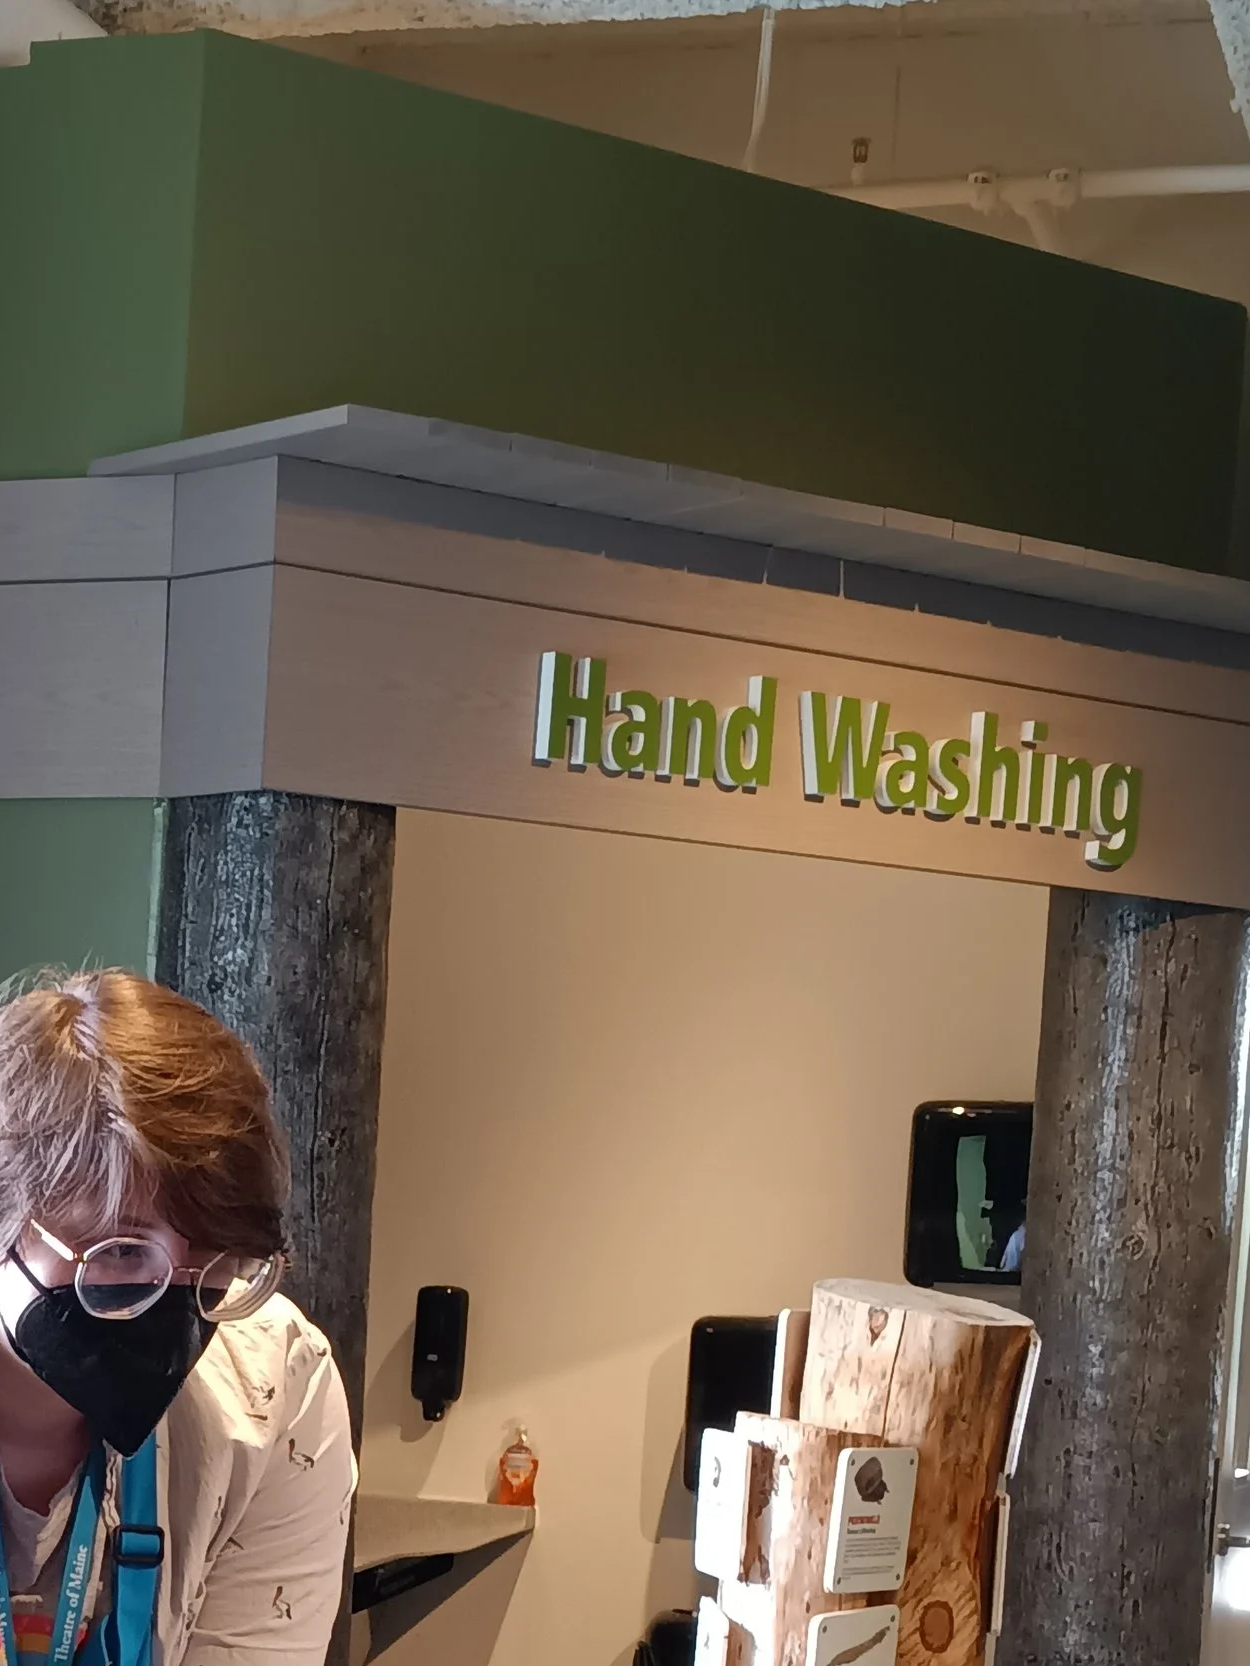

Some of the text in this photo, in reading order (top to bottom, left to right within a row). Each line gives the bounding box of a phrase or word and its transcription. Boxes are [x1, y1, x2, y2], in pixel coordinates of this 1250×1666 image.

[534, 650, 1143, 867] Hand Washing
[69, 1544, 89, 1590] Maine
[65, 1591, 79, 1608] of
[54, 1612, 78, 1661] Theatre
